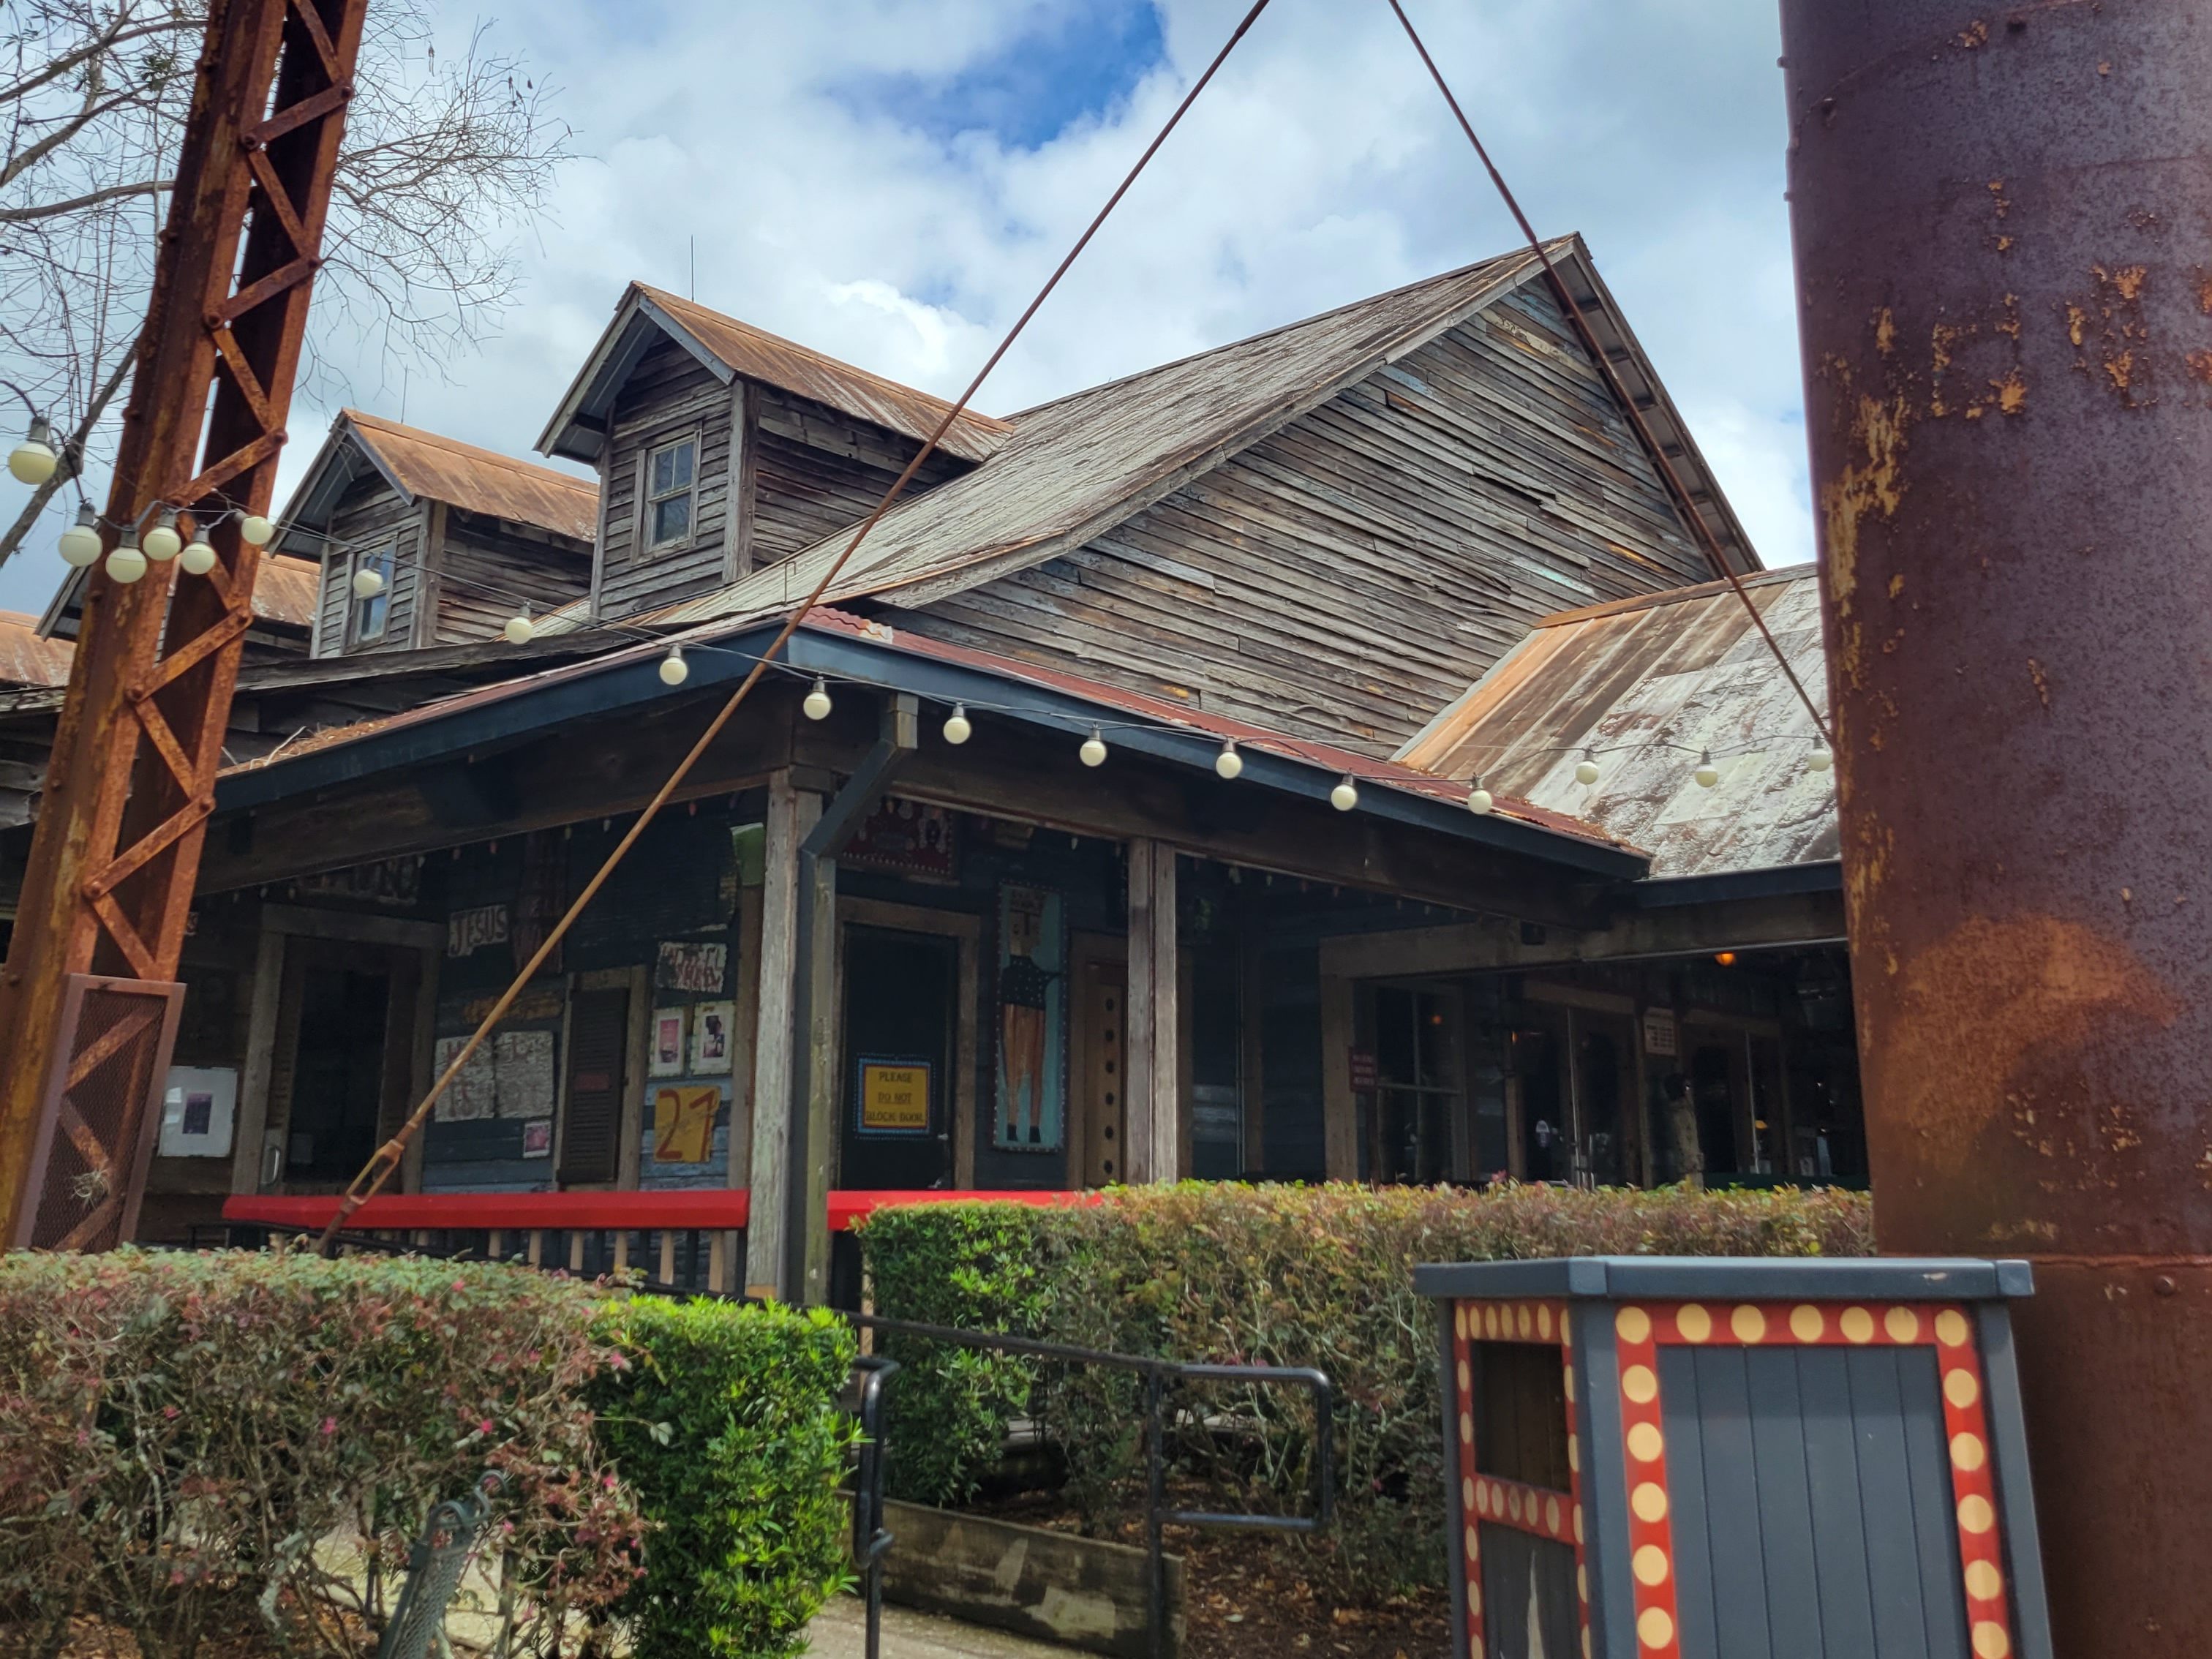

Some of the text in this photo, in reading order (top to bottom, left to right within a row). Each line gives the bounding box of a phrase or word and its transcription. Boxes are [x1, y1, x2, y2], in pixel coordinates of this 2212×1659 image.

[449, 907, 507, 956] JESUS
[879, 1072, 913, 1083] PLEASE
[878, 1092, 913, 1105] DO NOT
[866, 1110, 896, 1121] BLOCK
